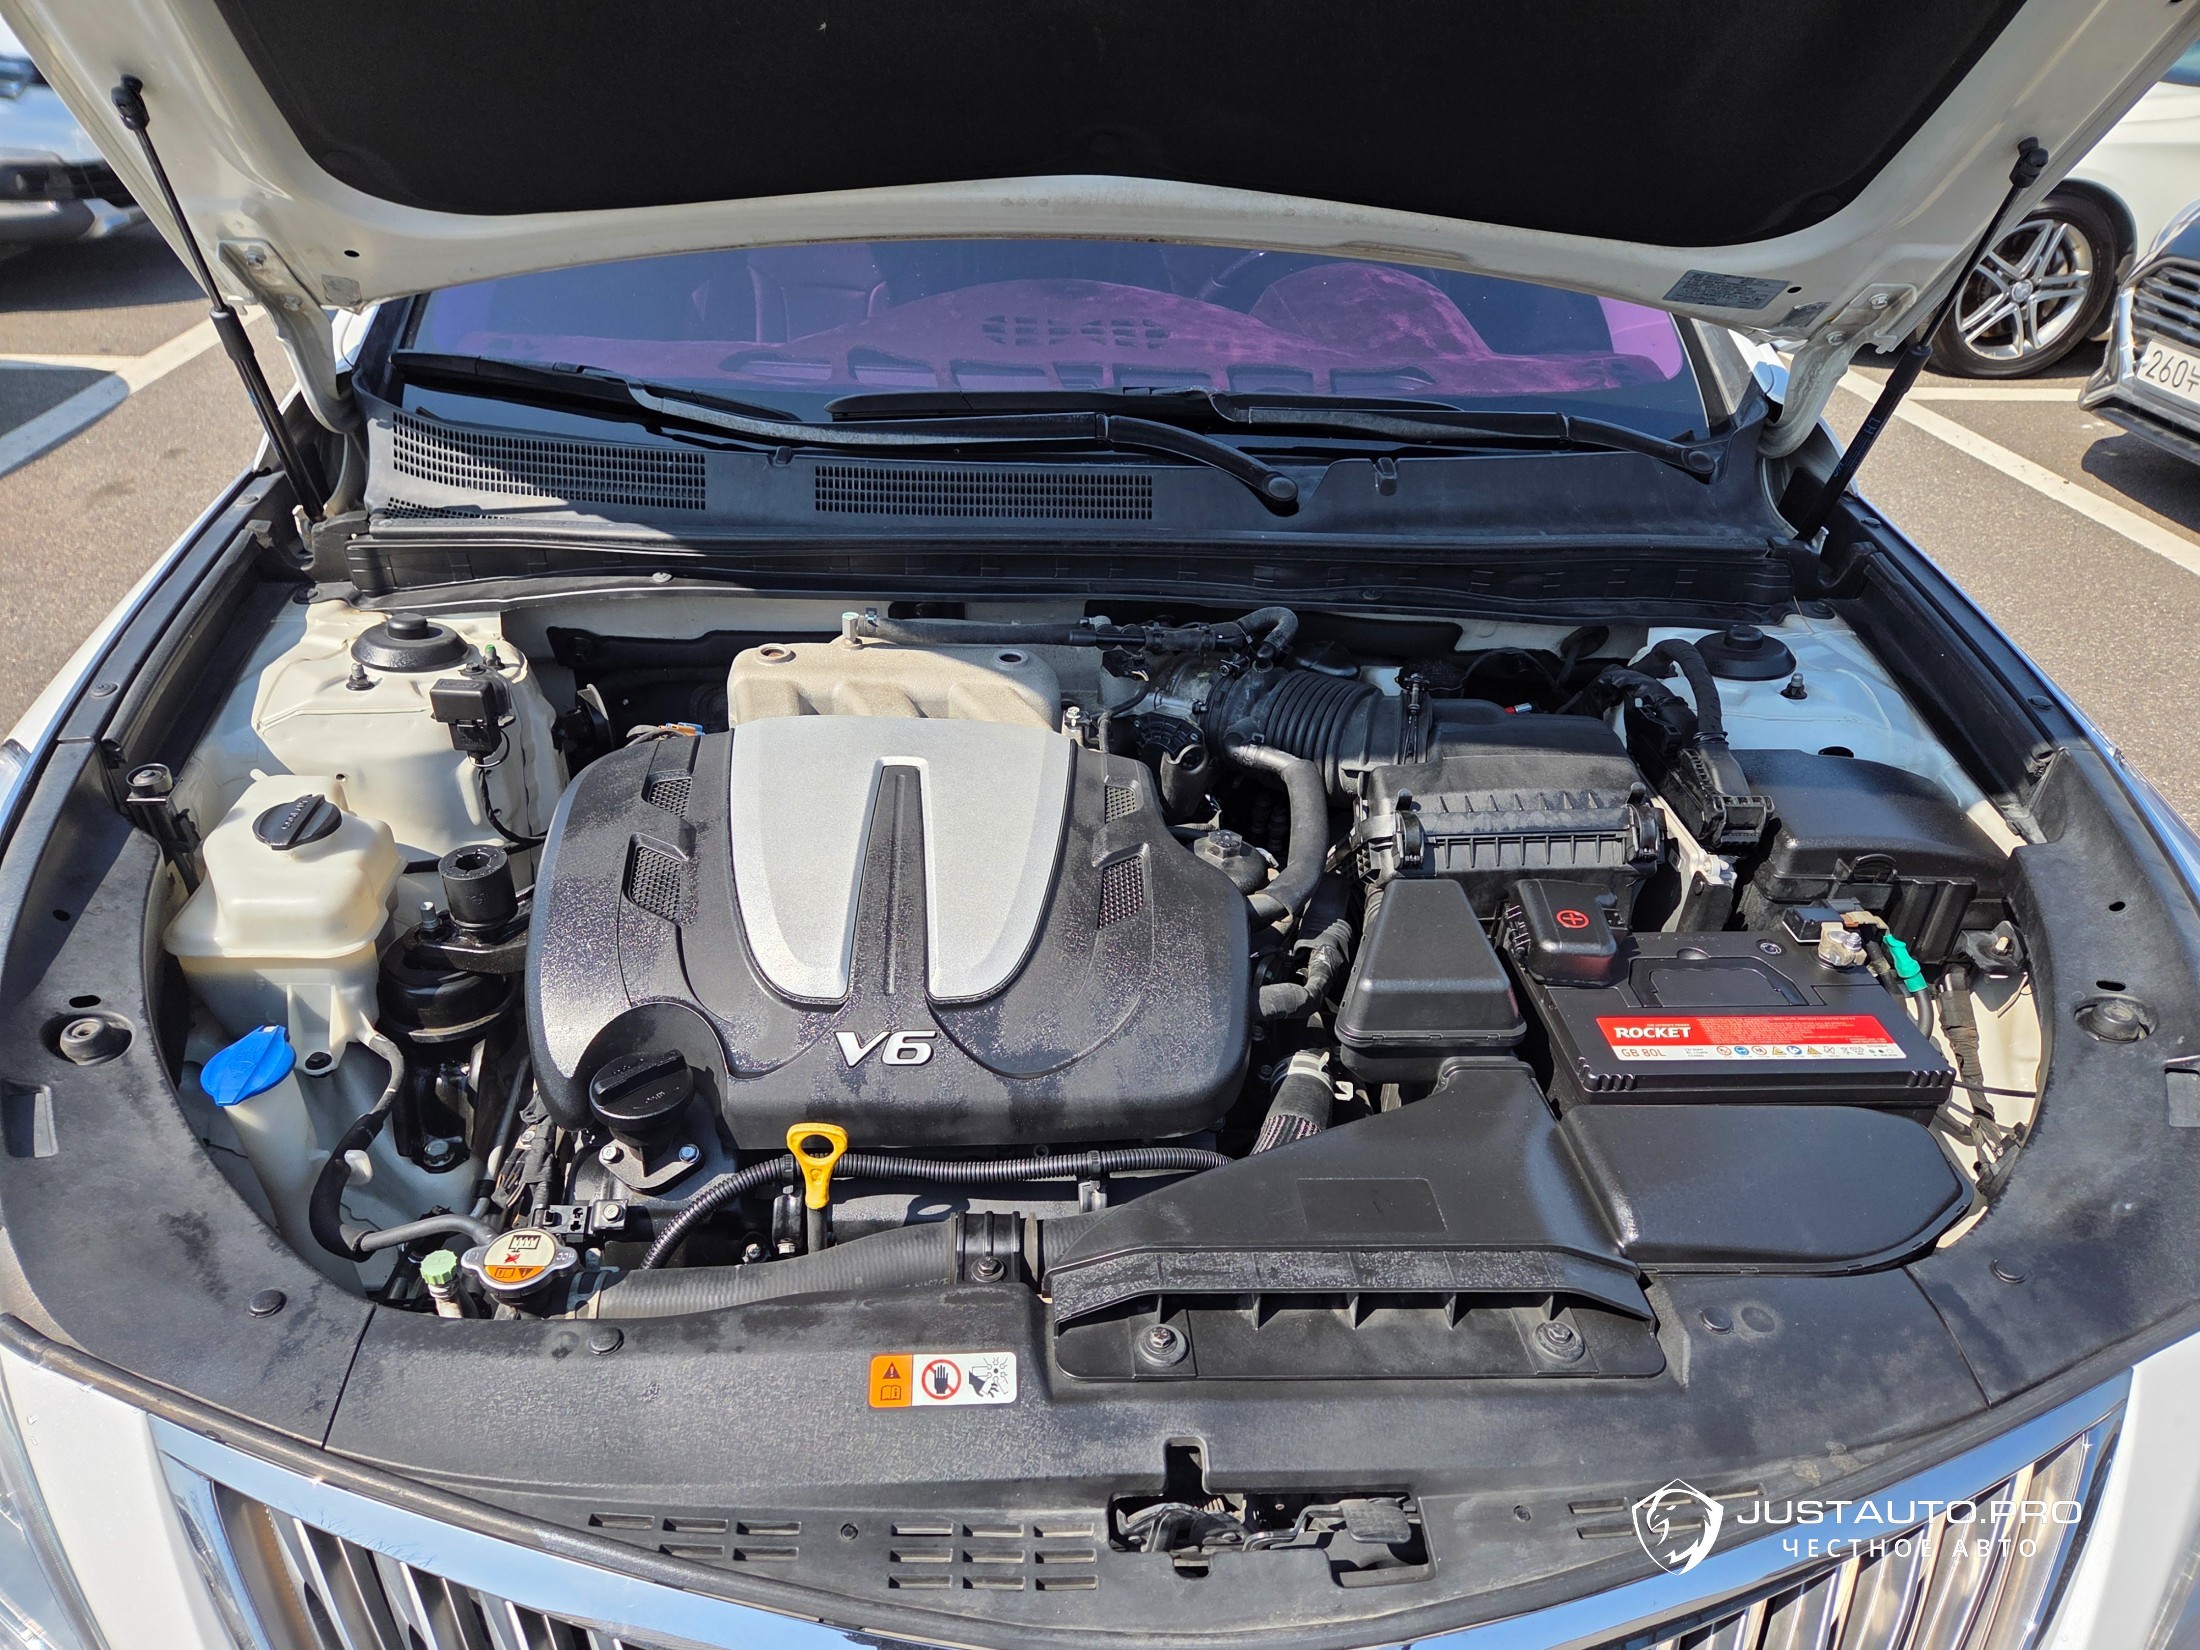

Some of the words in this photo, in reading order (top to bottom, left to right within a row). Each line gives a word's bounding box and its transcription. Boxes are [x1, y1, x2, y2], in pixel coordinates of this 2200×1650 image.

[1613, 1027, 1692, 1039] ROCKET
[834, 1030, 937, 1067] V6
[1621, 1048, 1640, 1057] GB
[1641, 1048, 1667, 1057] 80L
